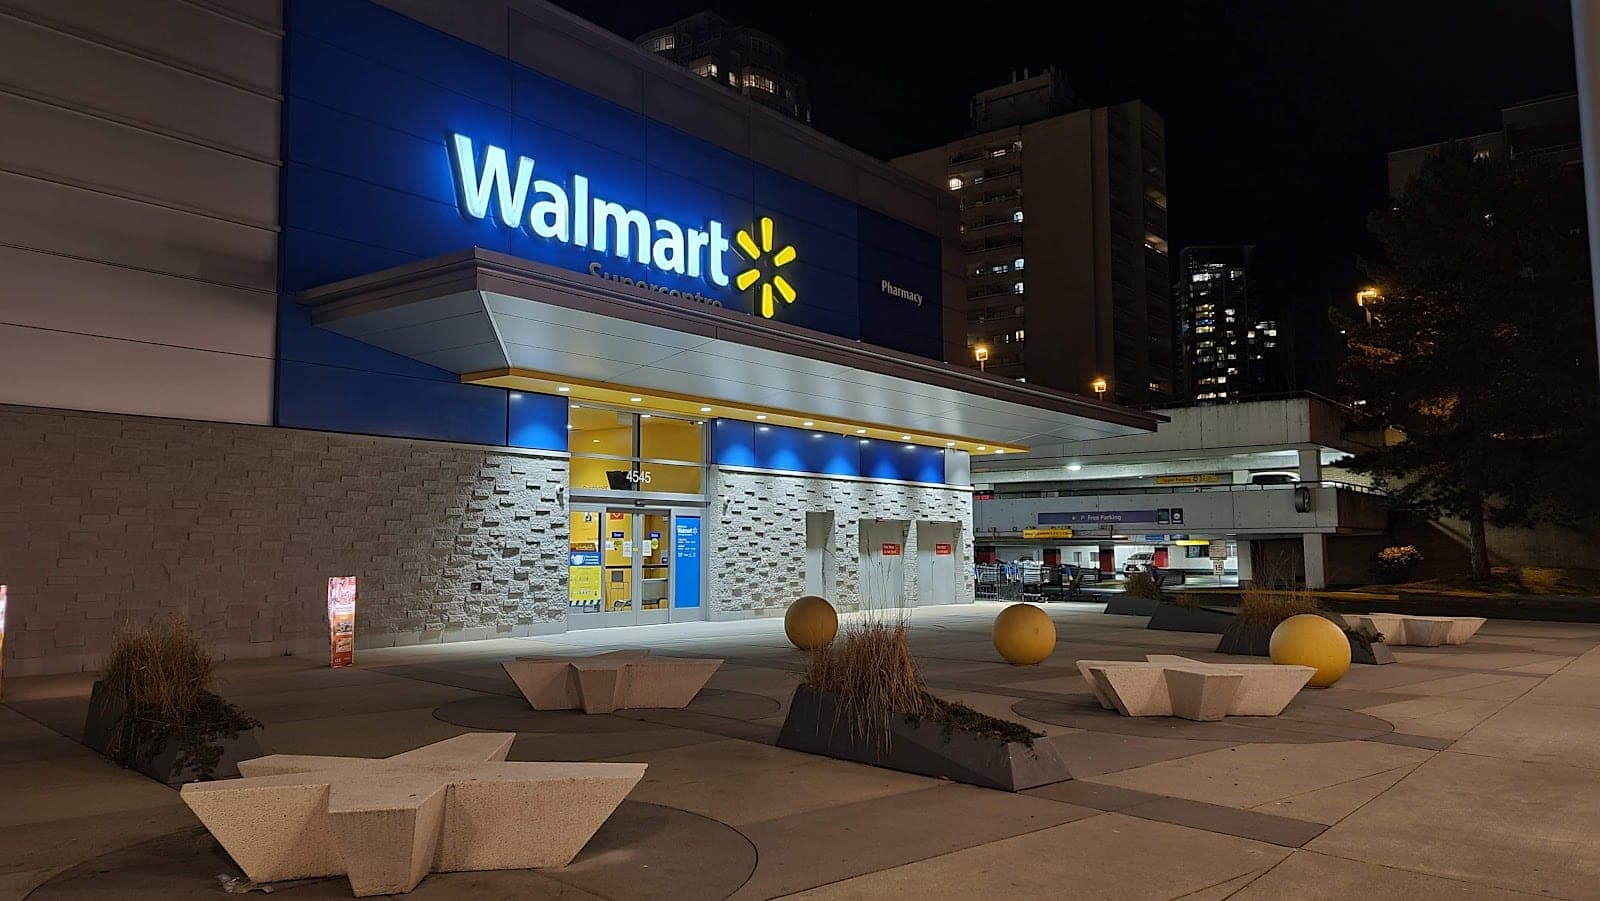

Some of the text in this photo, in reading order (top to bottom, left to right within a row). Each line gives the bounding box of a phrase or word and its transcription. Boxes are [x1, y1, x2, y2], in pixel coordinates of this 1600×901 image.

[449, 132, 729, 287] Walmart
[881, 279, 923, 306] Pharmacy
[626, 470, 652, 483] 4545
[1100, 513, 1122, 522] Parking
[1215, 564, 1223, 572] 15
